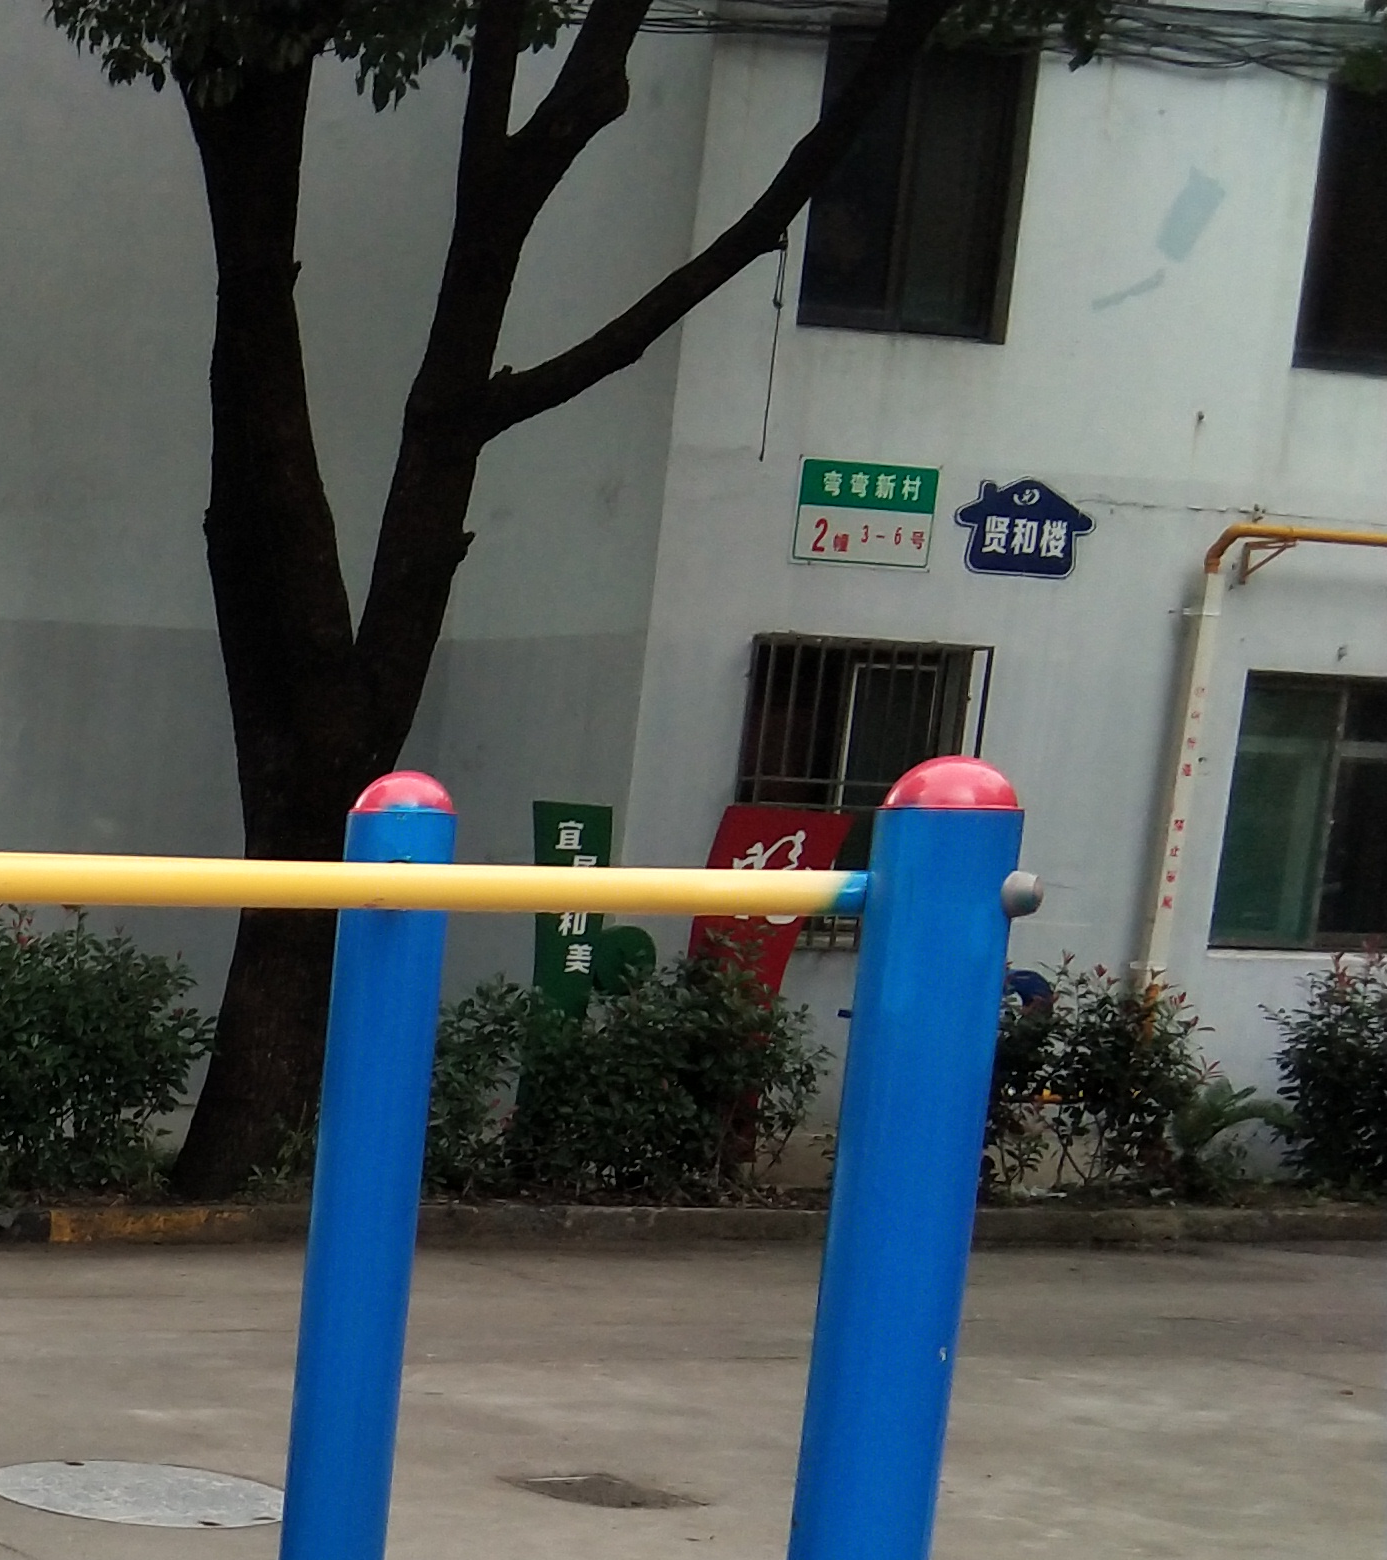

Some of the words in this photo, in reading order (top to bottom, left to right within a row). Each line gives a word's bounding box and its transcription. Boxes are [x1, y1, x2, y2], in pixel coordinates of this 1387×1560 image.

[823, 470, 923, 502] 弯弯新村
[982, 515, 1069, 559] 贤和楼
